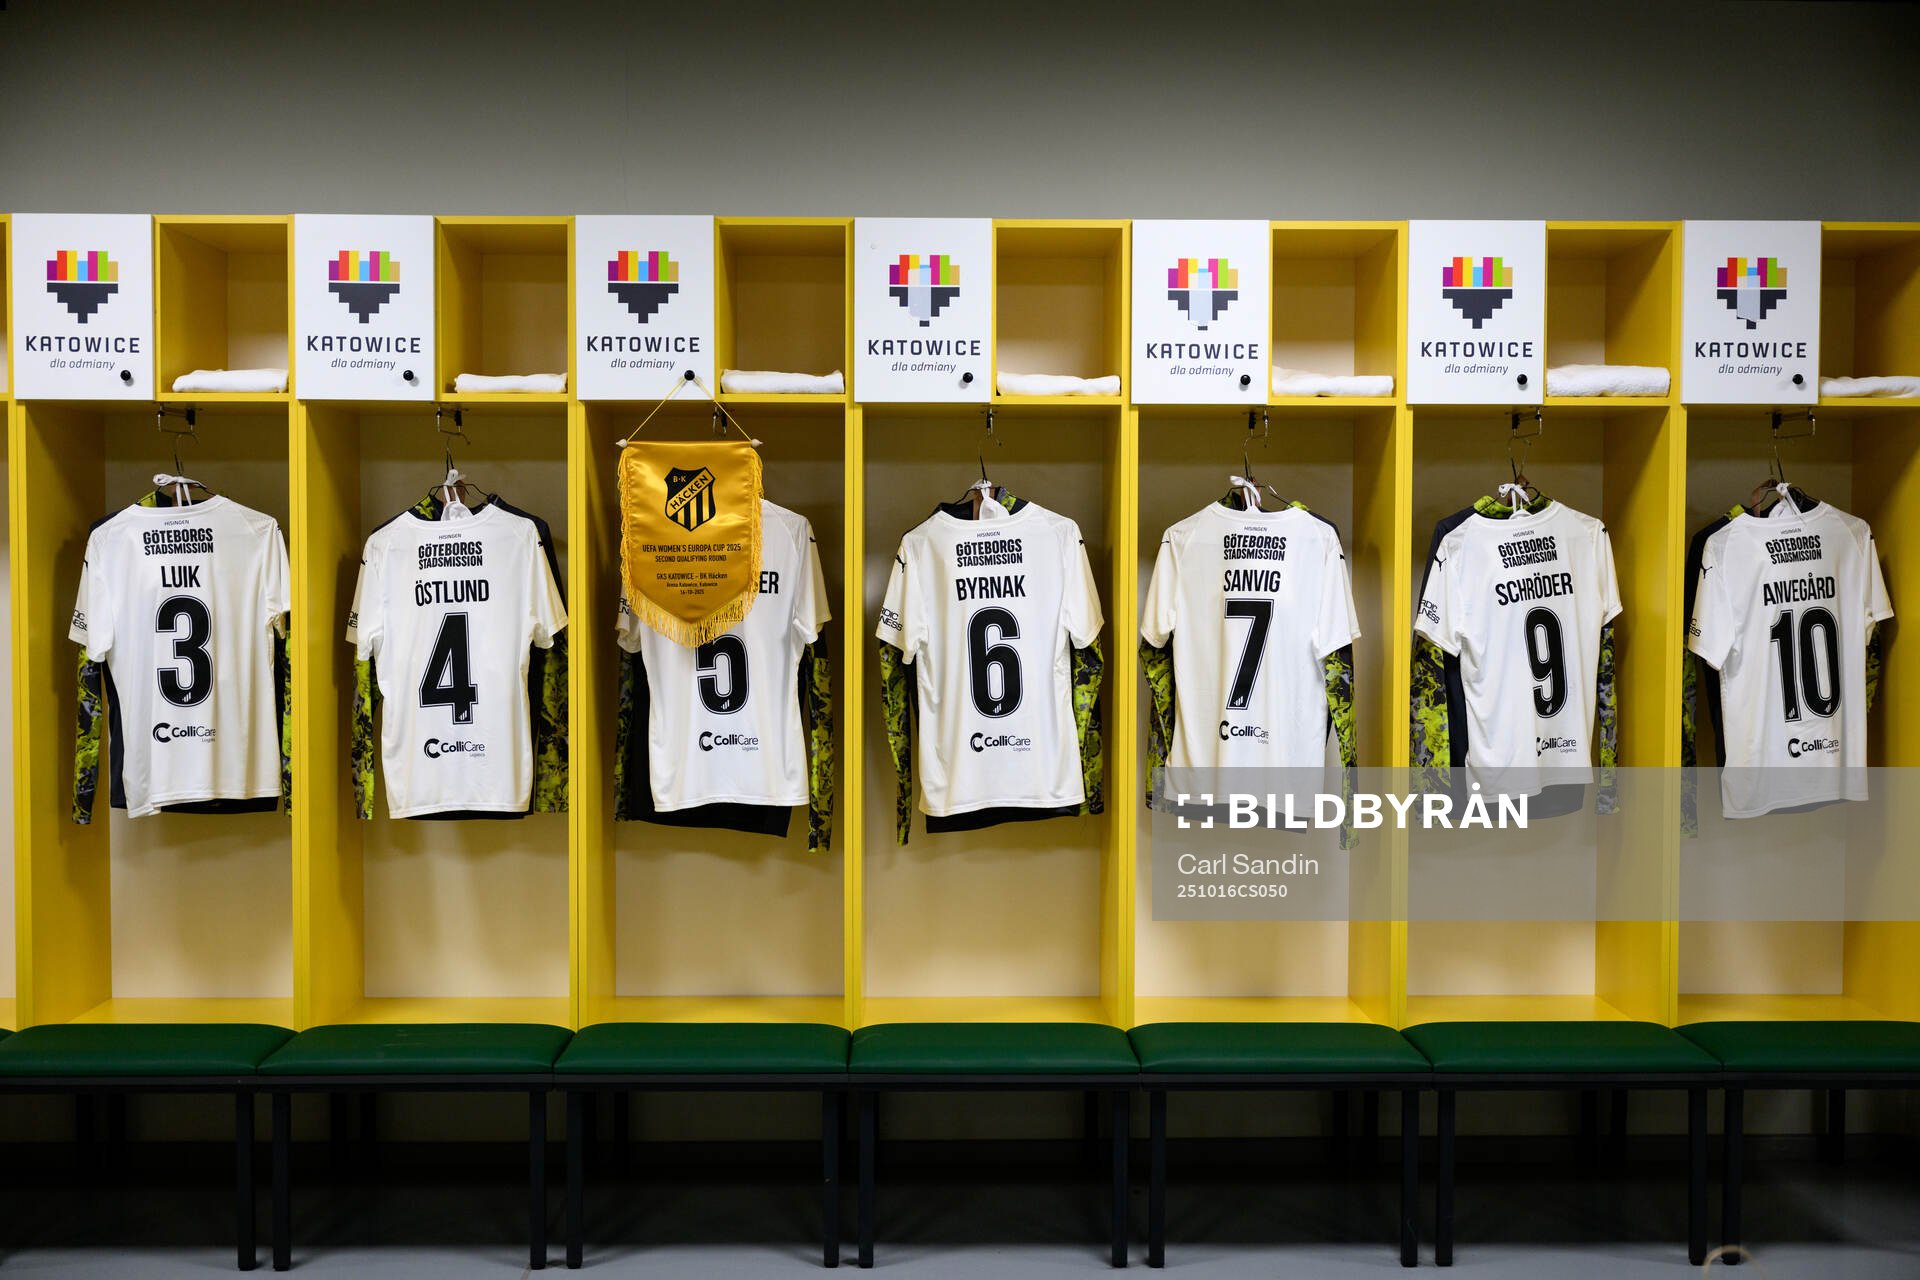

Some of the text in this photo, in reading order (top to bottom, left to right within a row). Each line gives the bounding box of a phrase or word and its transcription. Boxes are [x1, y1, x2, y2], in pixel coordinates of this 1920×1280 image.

[26, 336, 140, 354] KATOWICE
[307, 335, 421, 354] KATOWICE
[587, 335, 700, 353] KATOWICE
[868, 339, 981, 356] KATOWICE
[1146, 343, 1259, 360] KATOWICE
[1421, 342, 1533, 358] KATOWICE
[1695, 341, 1807, 358] KATOWICE
[50, 358, 115, 371] dla odmiany
[331, 358, 396, 371] dla odmiany
[610, 357, 675, 371] dla odmiany
[891, 361, 956, 374] dla odmiany
[1170, 364, 1234, 378] dla odmiany
[1444, 363, 1509, 376] dla odmiany
[1718, 363, 1782, 377] dla odmiany
[670, 474, 709, 510] HÄCKEN
[143, 528, 213, 545] GÖTEBORGS
[1223, 533, 1287, 550] GÖTEBORGS
[1765, 535, 1821, 554] GÖTEBORGS
[144, 542, 214, 556] STADSMISSION
[418, 541, 483, 559] GÖTEBORGS
[688, 544, 711, 552] EUROPA
[727, 543, 741, 551] 2025
[956, 539, 1022, 556] GÖTEBORGS
[1223, 548, 1285, 561] STADSMISSION
[1498, 536, 1556, 558] GÖTEBORGS
[418, 555, 483, 570] STADSMISSION
[957, 553, 1023, 567] STADSMISSION
[1502, 549, 1558, 569] STADSMISSION
[1770, 548, 1822, 565] STADSMISSION
[160, 565, 200, 588] LUIK
[1223, 569, 1281, 593] SANVIG
[415, 579, 489, 607] ÖSTLUND
[956, 575, 1026, 601] BYRNAK
[1495, 572, 1574, 606] SCHRÖDER
[1763, 572, 1835, 606] ANVEGÅRD
[155, 595, 213, 707] 3
[1224, 598, 1274, 710] 7
[419, 611, 478, 725] 4
[967, 606, 1024, 719] 6
[1524, 606, 1568, 719] 9
[1770, 606, 1841, 722] 10
[695, 634, 749, 715] 5
[440, 741, 485, 753] ColliCare
[714, 734, 759, 746] ColliCare
[984, 735, 1031, 747] ColliCare
